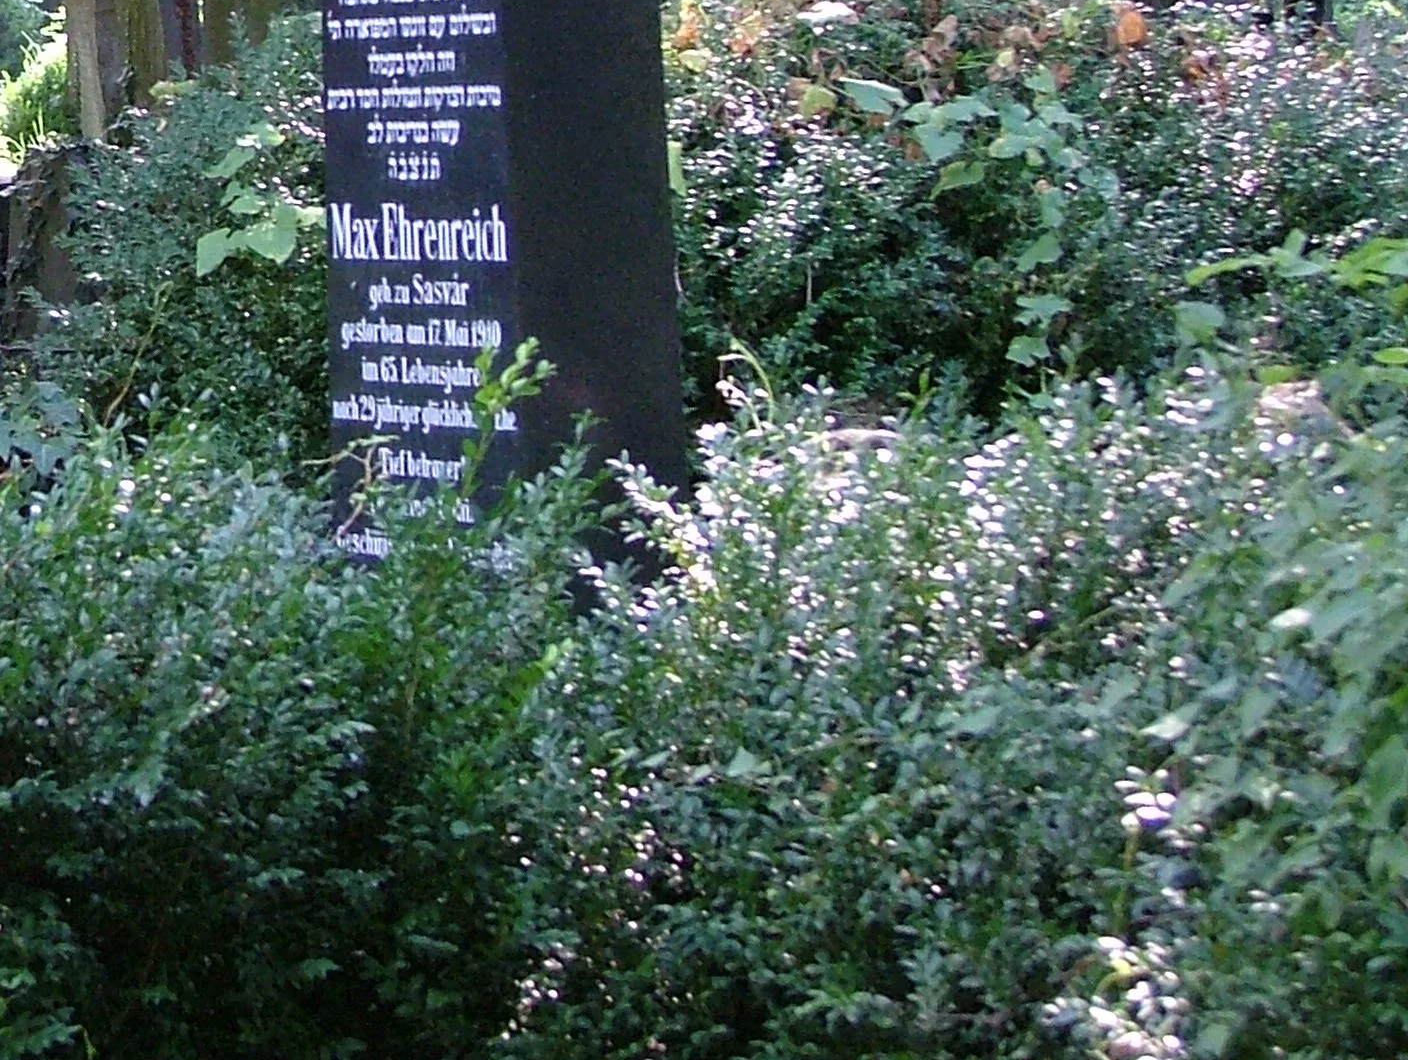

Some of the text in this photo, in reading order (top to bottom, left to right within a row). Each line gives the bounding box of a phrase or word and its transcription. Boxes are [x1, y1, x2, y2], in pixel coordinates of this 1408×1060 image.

[330, 202, 508, 262] Max Ehrenreich
[394, 285, 411, 305] zu
[342, 316, 404, 350] gestorben
[406, 323, 426, 345] am
[444, 318, 469, 347] Mai
[333, 394, 359, 420] nach
[377, 447, 406, 477] Tief
